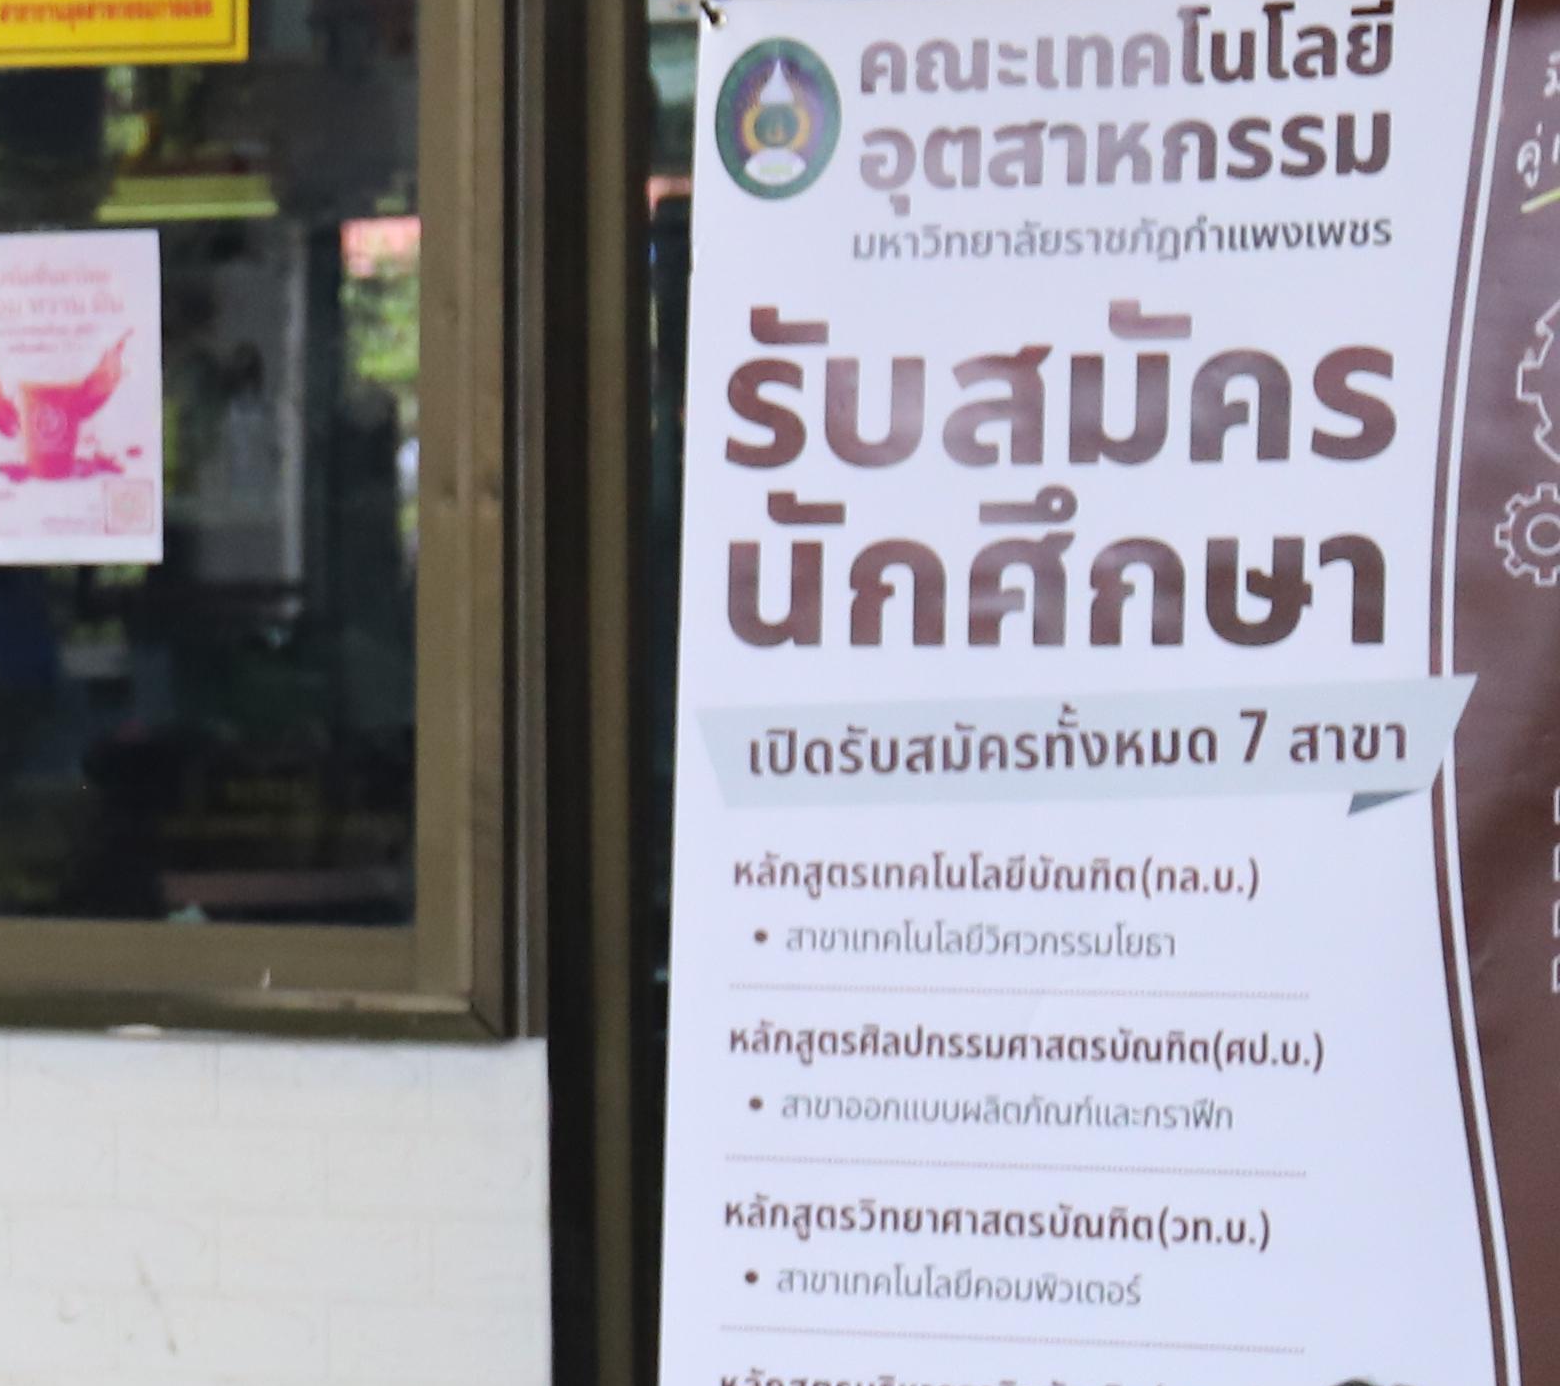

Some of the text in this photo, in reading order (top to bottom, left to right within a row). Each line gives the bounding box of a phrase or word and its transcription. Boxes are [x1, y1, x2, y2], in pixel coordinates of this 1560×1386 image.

[858, 109, 1392, 216] อุตสาหกรรม
[852, 216, 1392, 262] มหาวิทยาลัยราชภัฏกำแพงเพชร
[724, 299, 1398, 468] รับสมัคร
[727, 484, 1387, 649] นักศึกษา
[749, 703, 1408, 776] เปิดรับสมัครทั้งหมด 7 สาขา
[733, 853, 1262, 903] หลักสูตรเทคโนโลยีบัณฑิต(ทล.บ.)
[785, 922, 1177, 961] สาขาเทคโนโลยีวิศวกรรมโยธา
[728, 1020, 1325, 1072] หลักสูตรศิลปกรรมศาสตรบัณฑิต(ศป.บ.)
[724, 1196, 1272, 1248] หลักสูตรวิทยาศาสตรบัณฑิต(วท.บ.)
[776, 1263, 1143, 1307] สาขาเทคโนโลยีคอมพิวเตอร์
